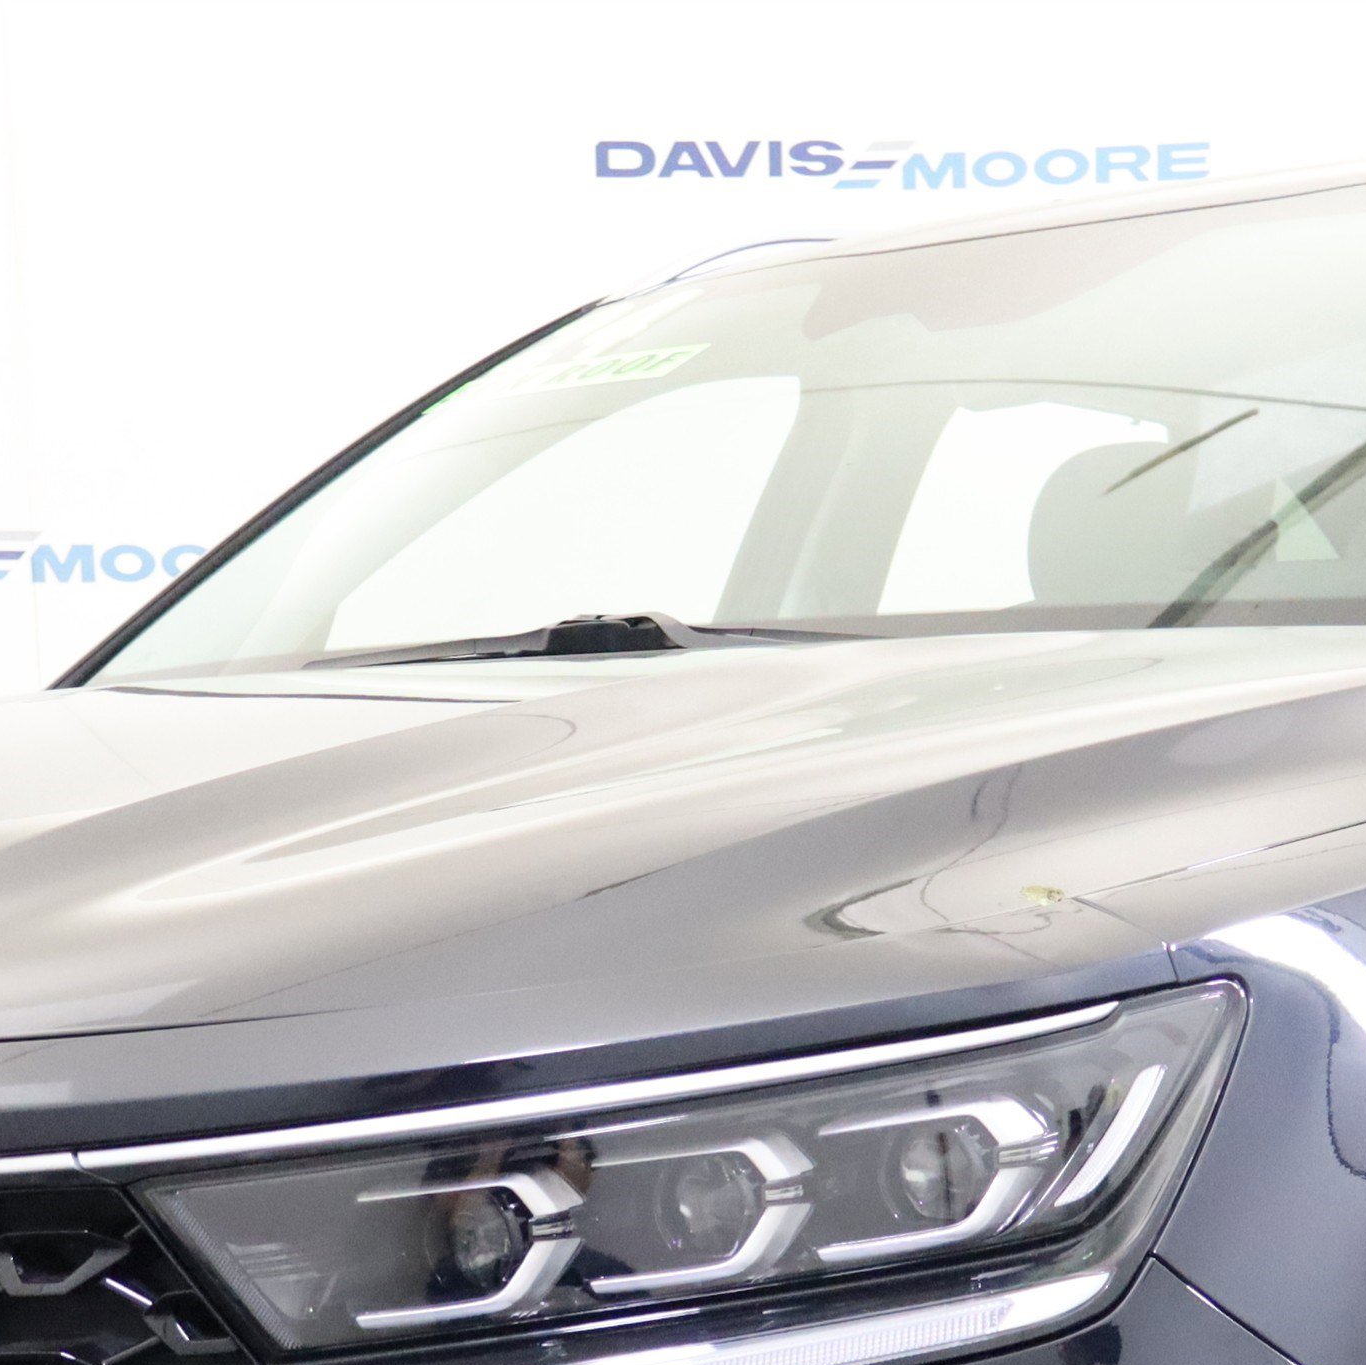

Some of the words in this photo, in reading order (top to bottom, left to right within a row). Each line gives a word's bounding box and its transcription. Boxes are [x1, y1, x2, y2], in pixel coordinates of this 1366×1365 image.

[595, 140, 845, 178] DAVIS
[902, 142, 1210, 190] MOORE
[29, 544, 208, 583] MOO
